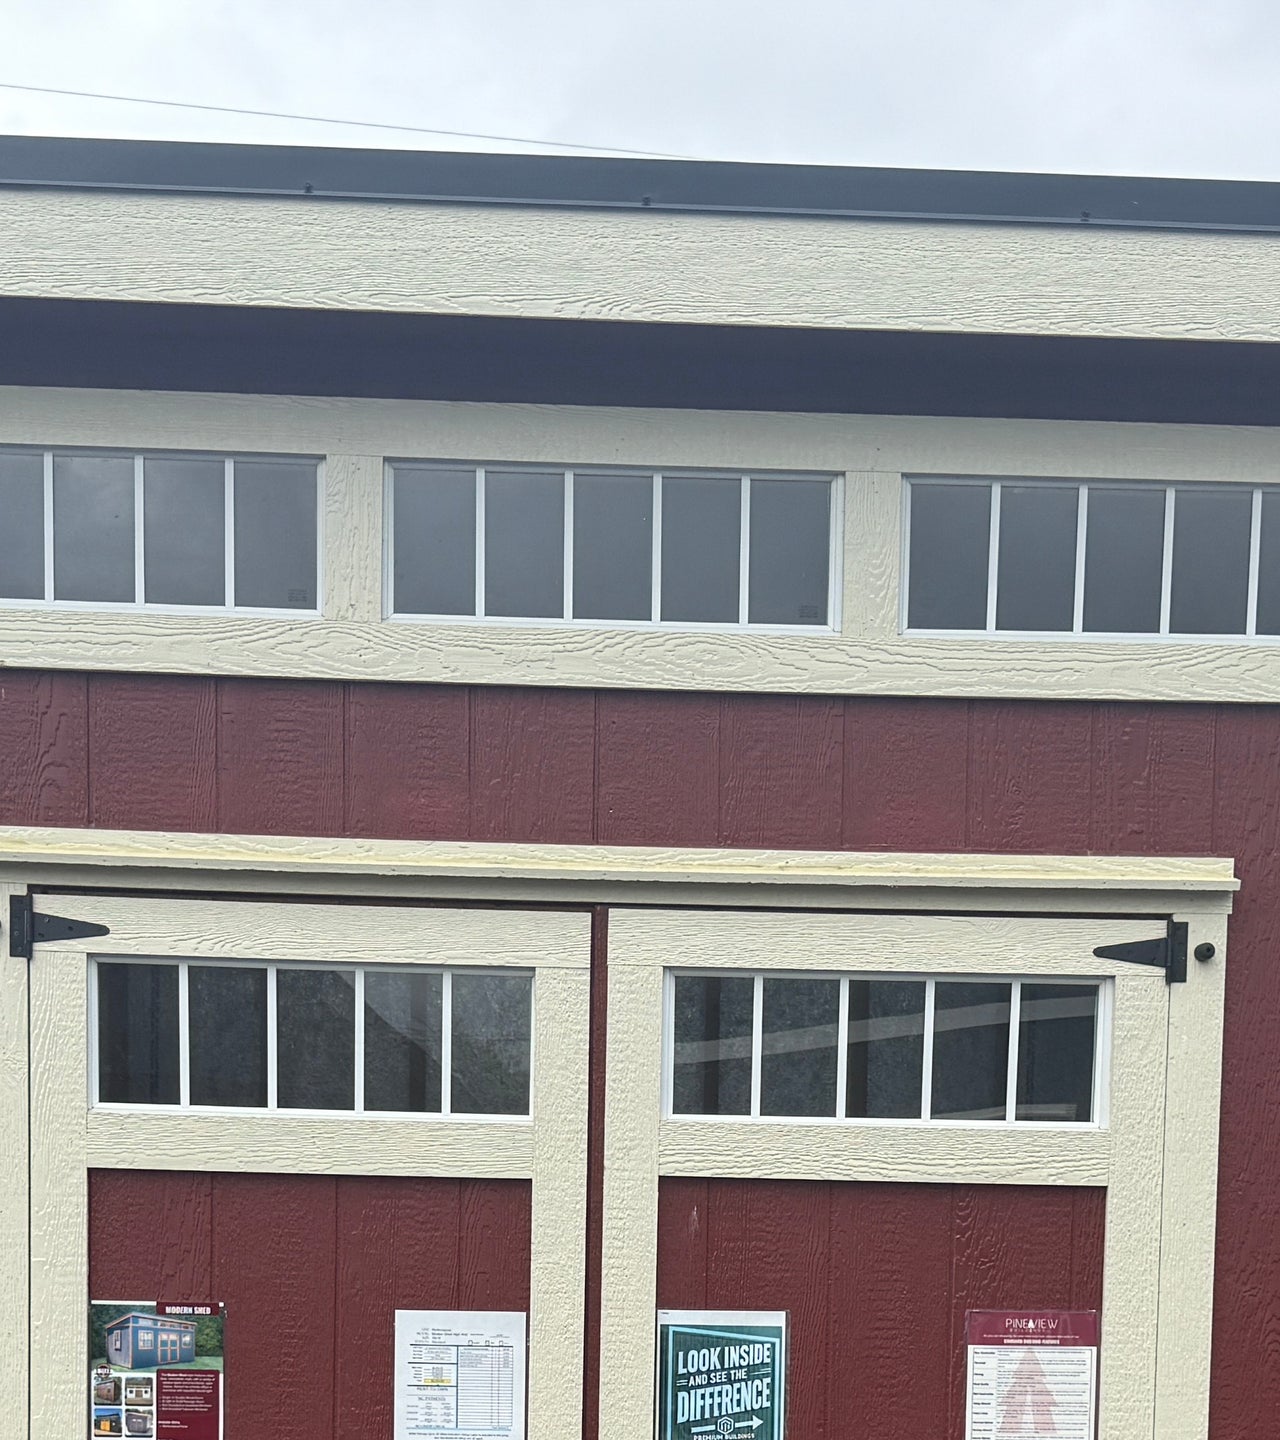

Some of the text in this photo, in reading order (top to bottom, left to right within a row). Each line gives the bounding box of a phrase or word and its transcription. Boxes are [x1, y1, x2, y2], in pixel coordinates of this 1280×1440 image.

[165, 1305, 212, 1315] MODERN SHED
[1005, 1318, 1058, 1329] PINEVIEW
[677, 1343, 772, 1375] LOOK INSIDE
[688, 1368, 748, 1387] AND SEE THE
[677, 1377, 772, 1424] DIFFERENCE
[725, 1432, 755, 1440] BUILDINGS
